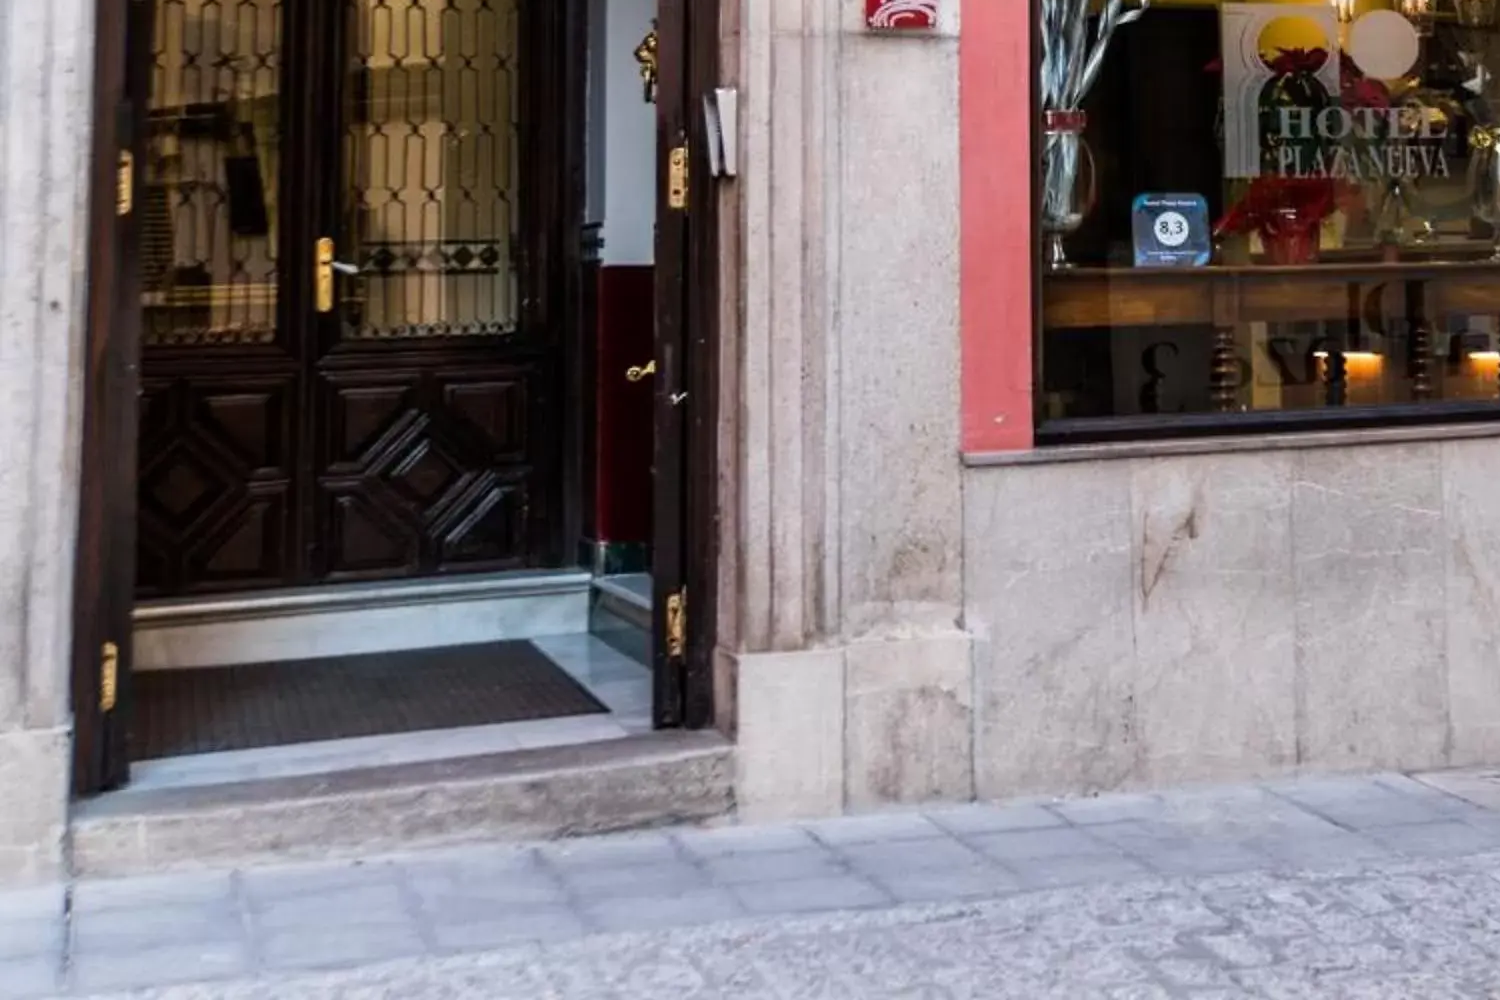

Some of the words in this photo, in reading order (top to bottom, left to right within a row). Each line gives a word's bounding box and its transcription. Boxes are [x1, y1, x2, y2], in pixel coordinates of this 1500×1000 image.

[1279, 106, 1448, 139] HOTEL
[1279, 146, 1364, 178] PLAZA
[1367, 146, 1450, 179] NUEVA
[1159, 220, 1183, 236] 8,3
